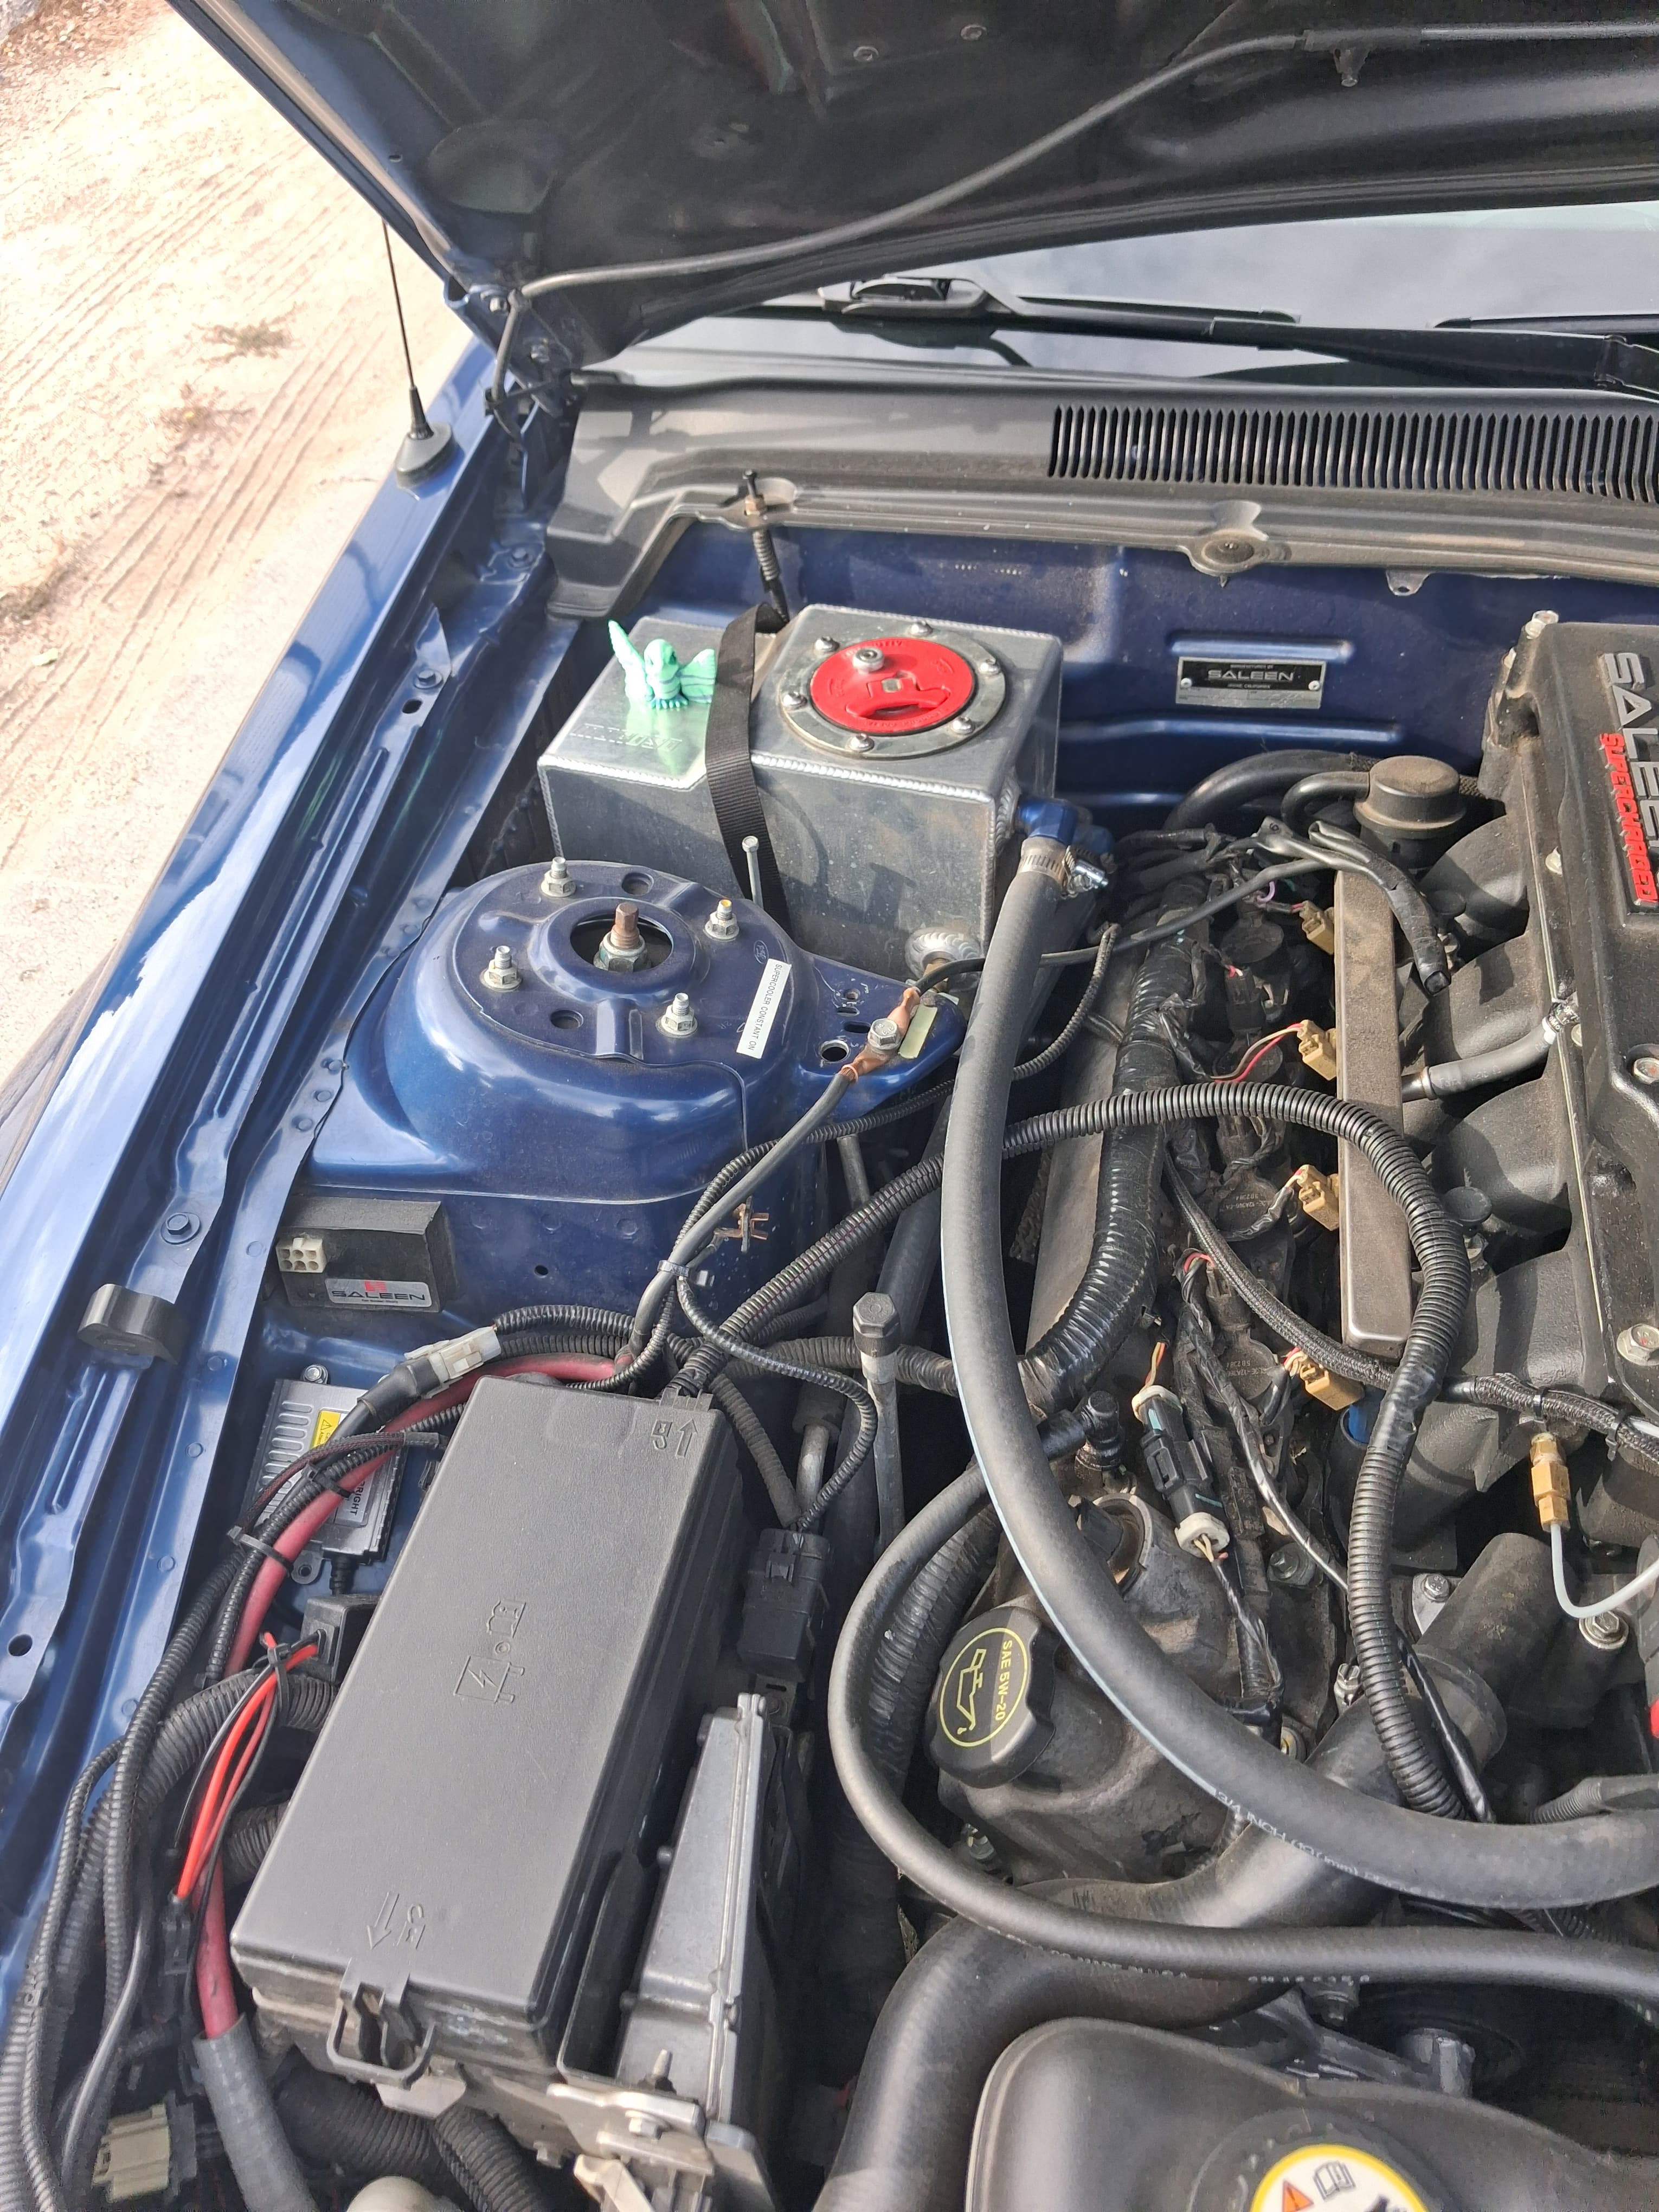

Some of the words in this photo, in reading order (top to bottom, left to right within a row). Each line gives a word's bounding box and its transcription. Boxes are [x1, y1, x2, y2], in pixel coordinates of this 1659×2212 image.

[1208, 669, 1295, 681] SALEEN
[1604, 652, 1659, 881] SALEE
[1600, 733, 1659, 902] SUPERCHARGED
[763, 963, 783, 1005] SUPERCOOLER
[752, 1006, 768, 1039] CONSTANT
[748, 1040, 757, 1051] ON
[332, 1290, 426, 1301] SALEEN
[1001, 1639, 1013, 1670] SAE
[995, 1673, 1010, 1721] 5W-20
